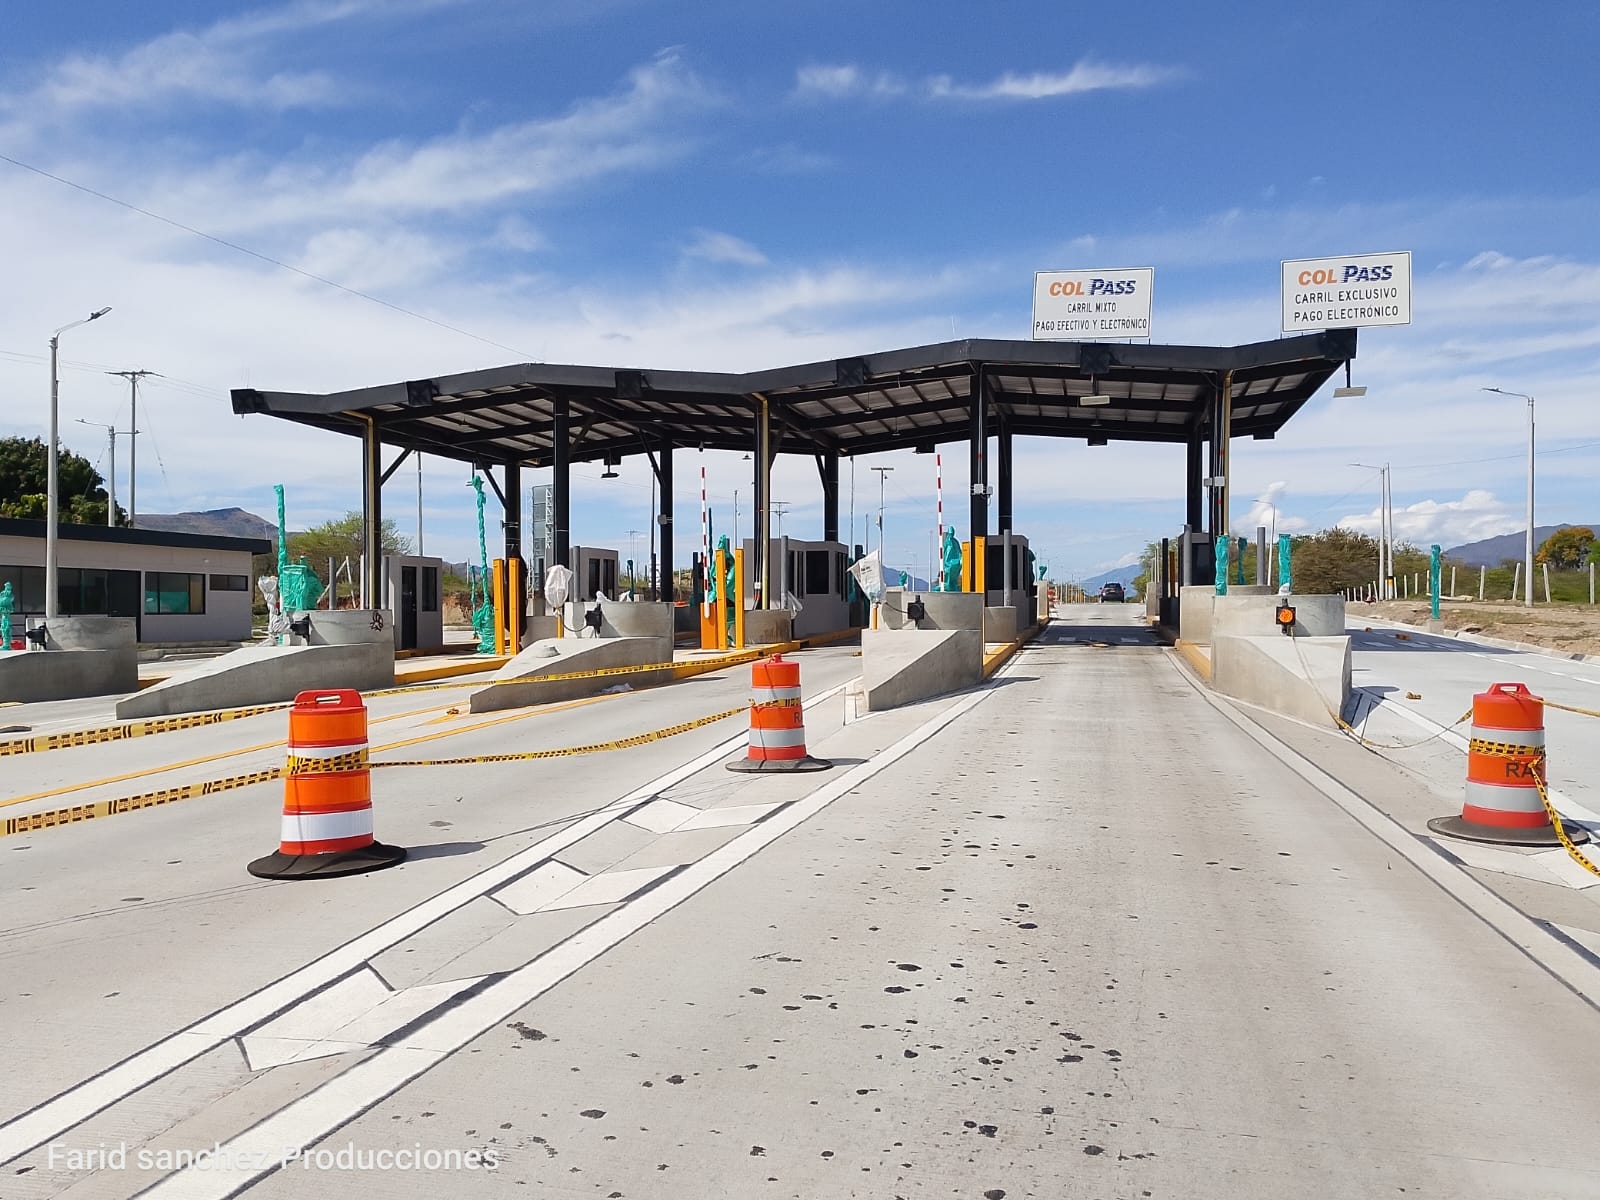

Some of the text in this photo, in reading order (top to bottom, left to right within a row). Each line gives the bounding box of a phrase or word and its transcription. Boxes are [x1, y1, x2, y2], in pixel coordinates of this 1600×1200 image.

[1298, 265, 1393, 286] COL PASS
[1049, 278, 1137, 297] COL PASS
[1295, 287, 1397, 305] CARRIL EXCLUSIVO
[1067, 302, 1117, 313] CARRIL MIXTO
[1294, 305, 1398, 322] PAGO ELECTRÓNICO
[1035, 315, 1147, 331] PAGO EFECTIVO Y ELECTRÓNICO
[17, 815, 54, 828] PELIGRO
[59, 812, 70, 821] NO
